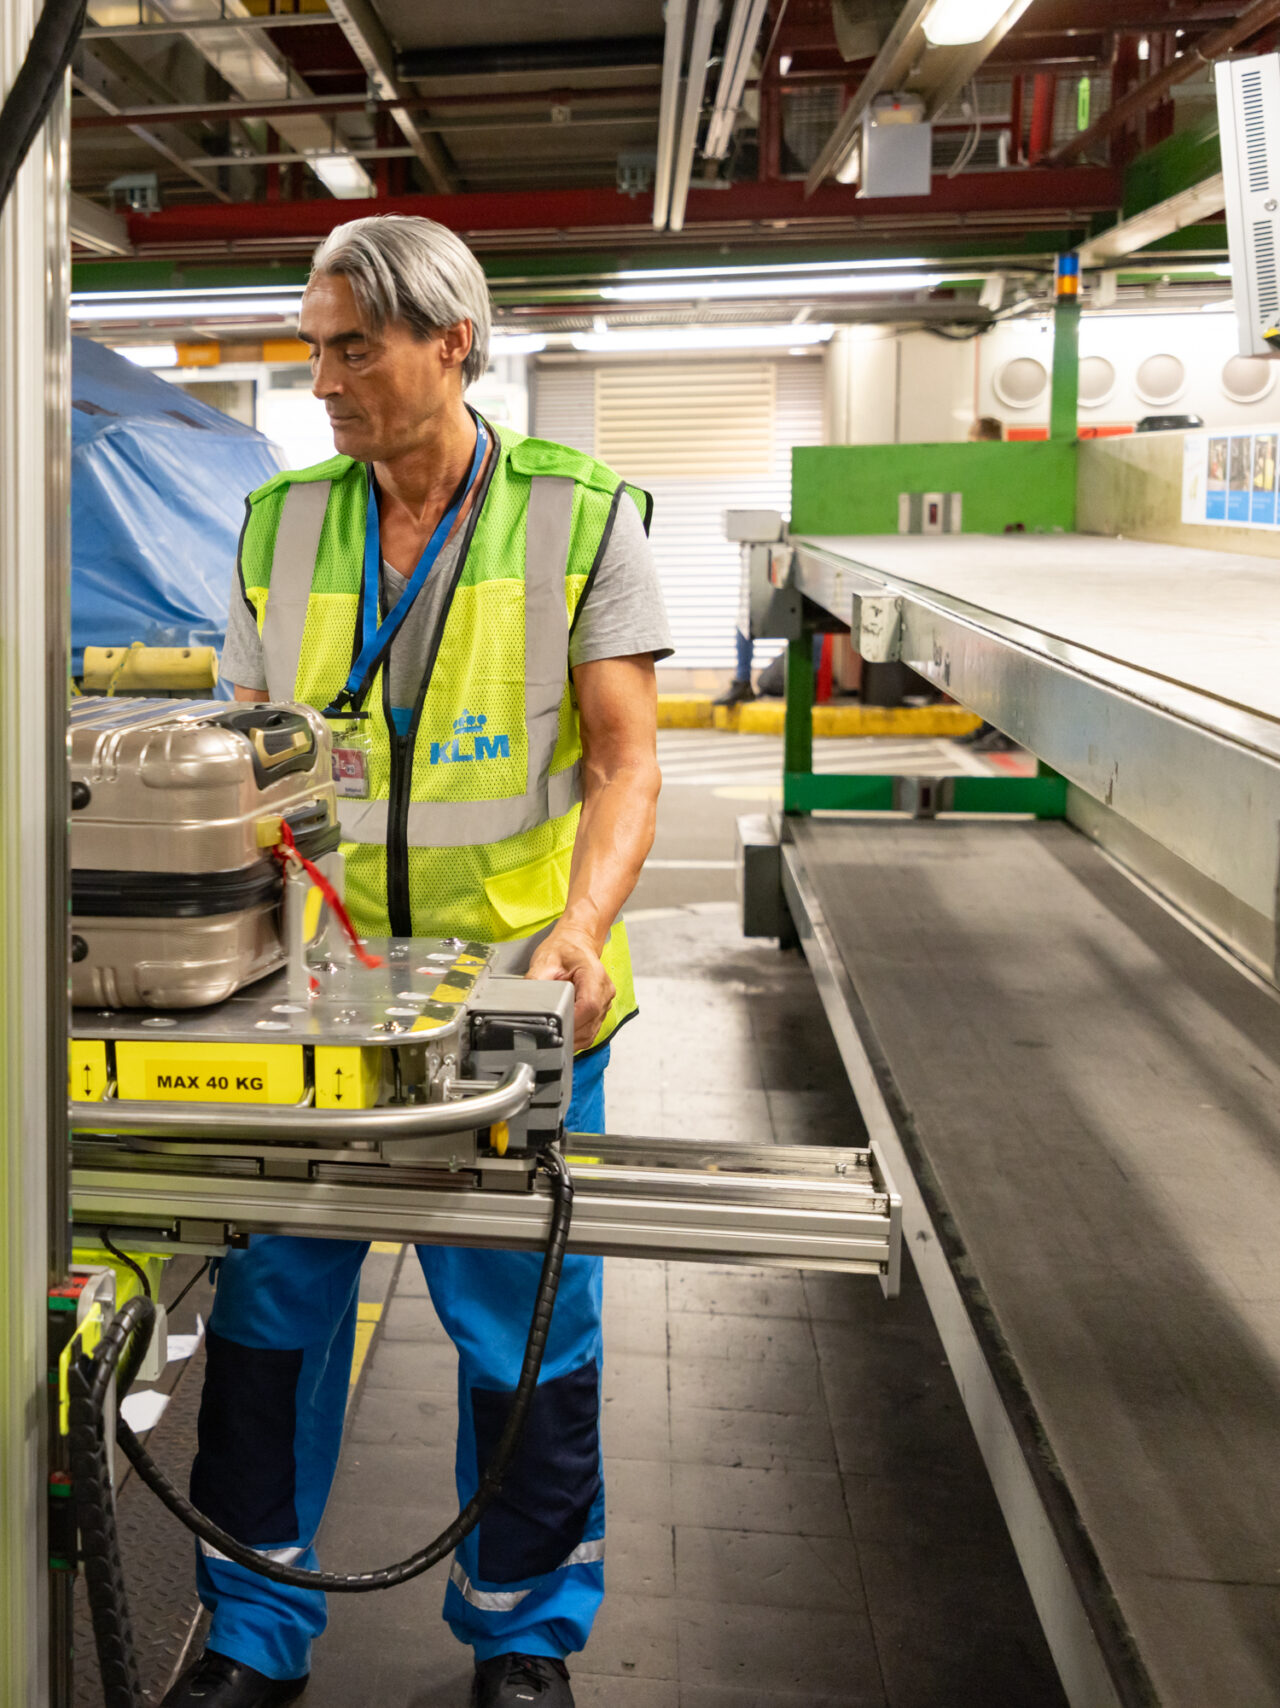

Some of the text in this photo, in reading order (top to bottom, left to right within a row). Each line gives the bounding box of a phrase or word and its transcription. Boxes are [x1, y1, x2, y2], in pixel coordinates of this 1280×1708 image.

[429, 734, 511, 766] KLM
[157, 1075, 264, 1091] MAX 40 KG
